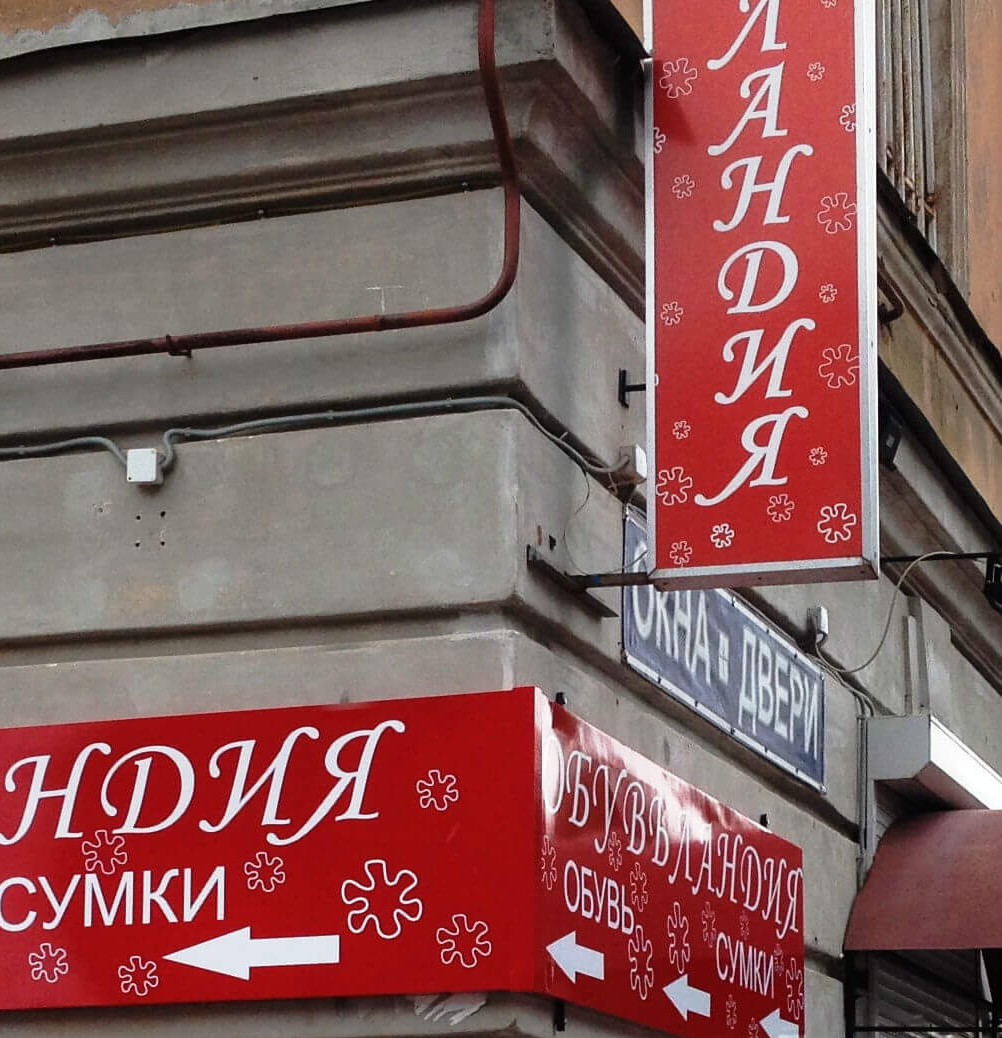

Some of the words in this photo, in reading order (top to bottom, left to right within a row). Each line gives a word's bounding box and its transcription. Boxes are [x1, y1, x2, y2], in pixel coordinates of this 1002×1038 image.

[694, 0, 816, 507] ЛАНДИЯ
[631, 540, 711, 687] ОКНА
[738, 625, 819, 761] ДВЕРИ
[563, 859, 635, 934] ОБУВЬ
[715, 931, 775, 999] СУМКИ
